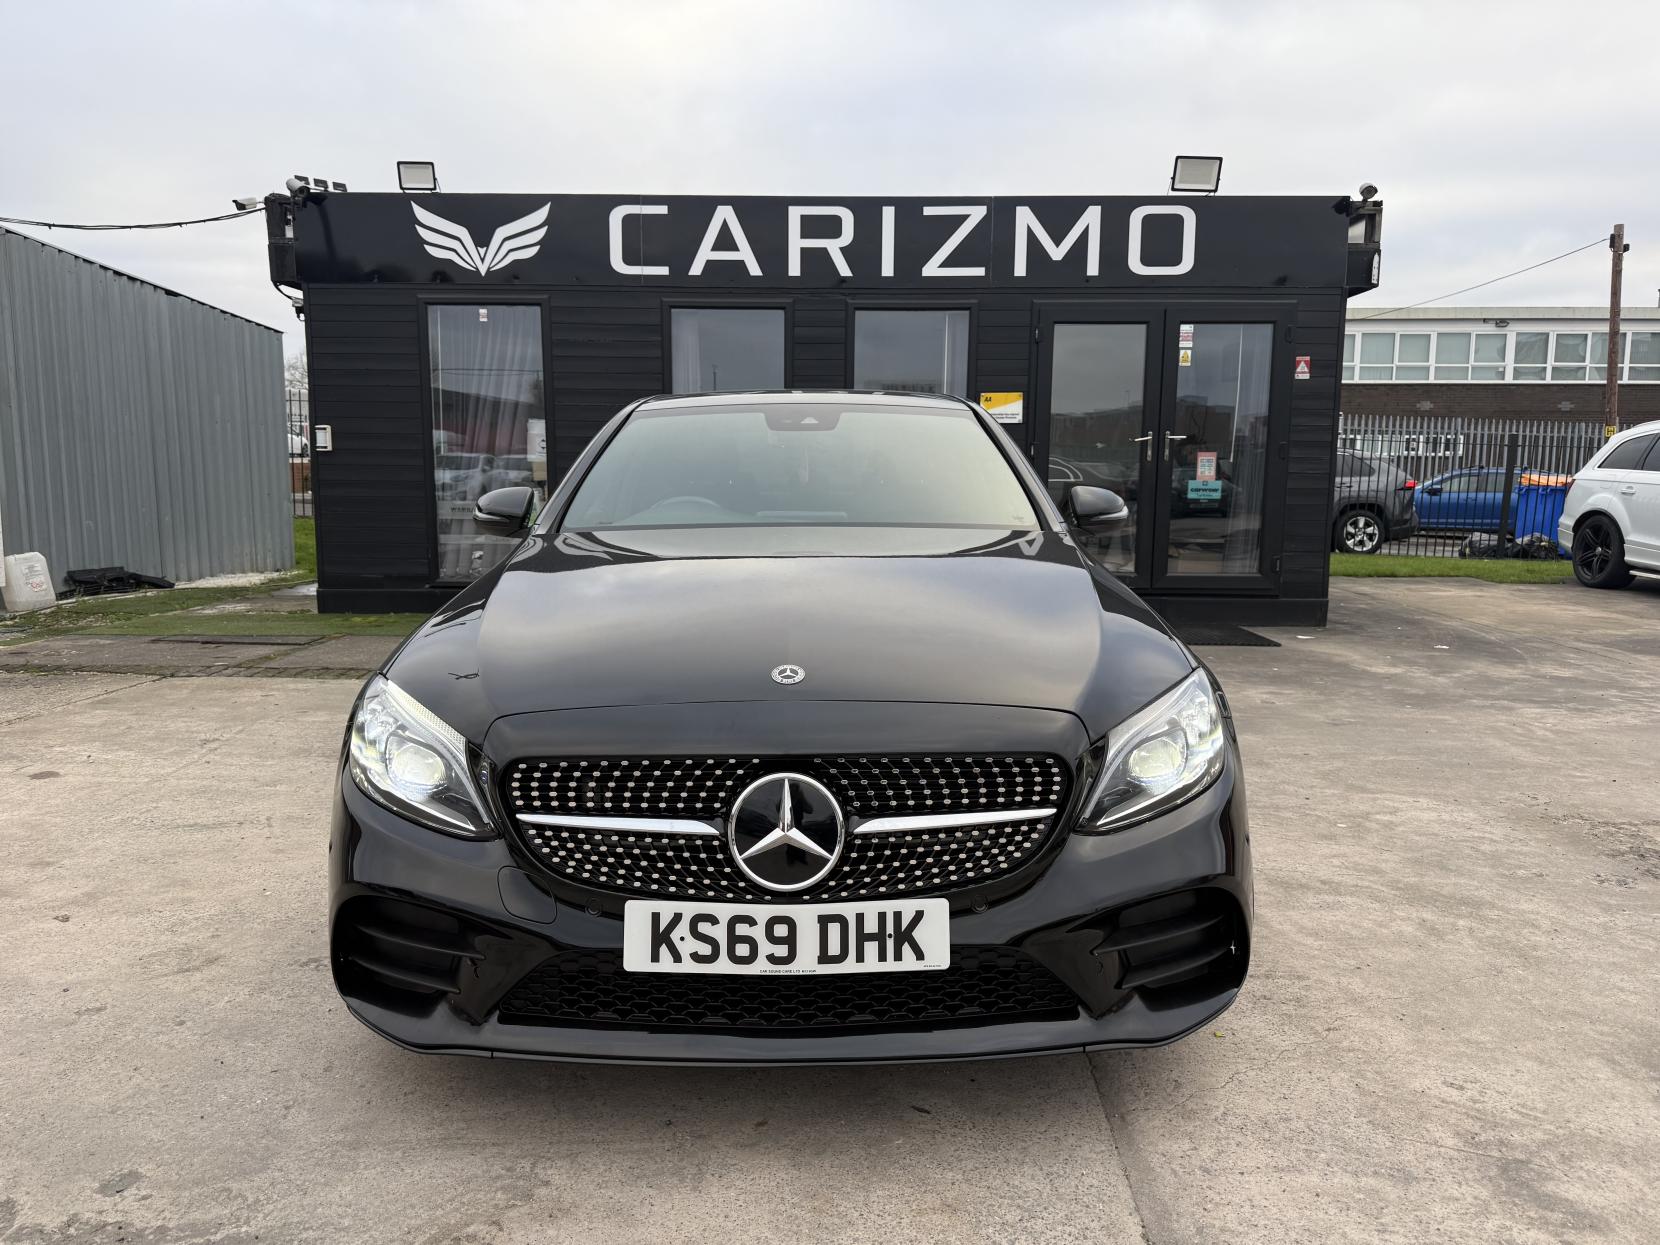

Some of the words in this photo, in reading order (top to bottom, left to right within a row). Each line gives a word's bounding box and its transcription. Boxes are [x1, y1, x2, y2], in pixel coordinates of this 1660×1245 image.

[608, 204, 1197, 277] CARIZMO
[650, 911, 798, 965] KS69
[817, 909, 925, 965] DHK
